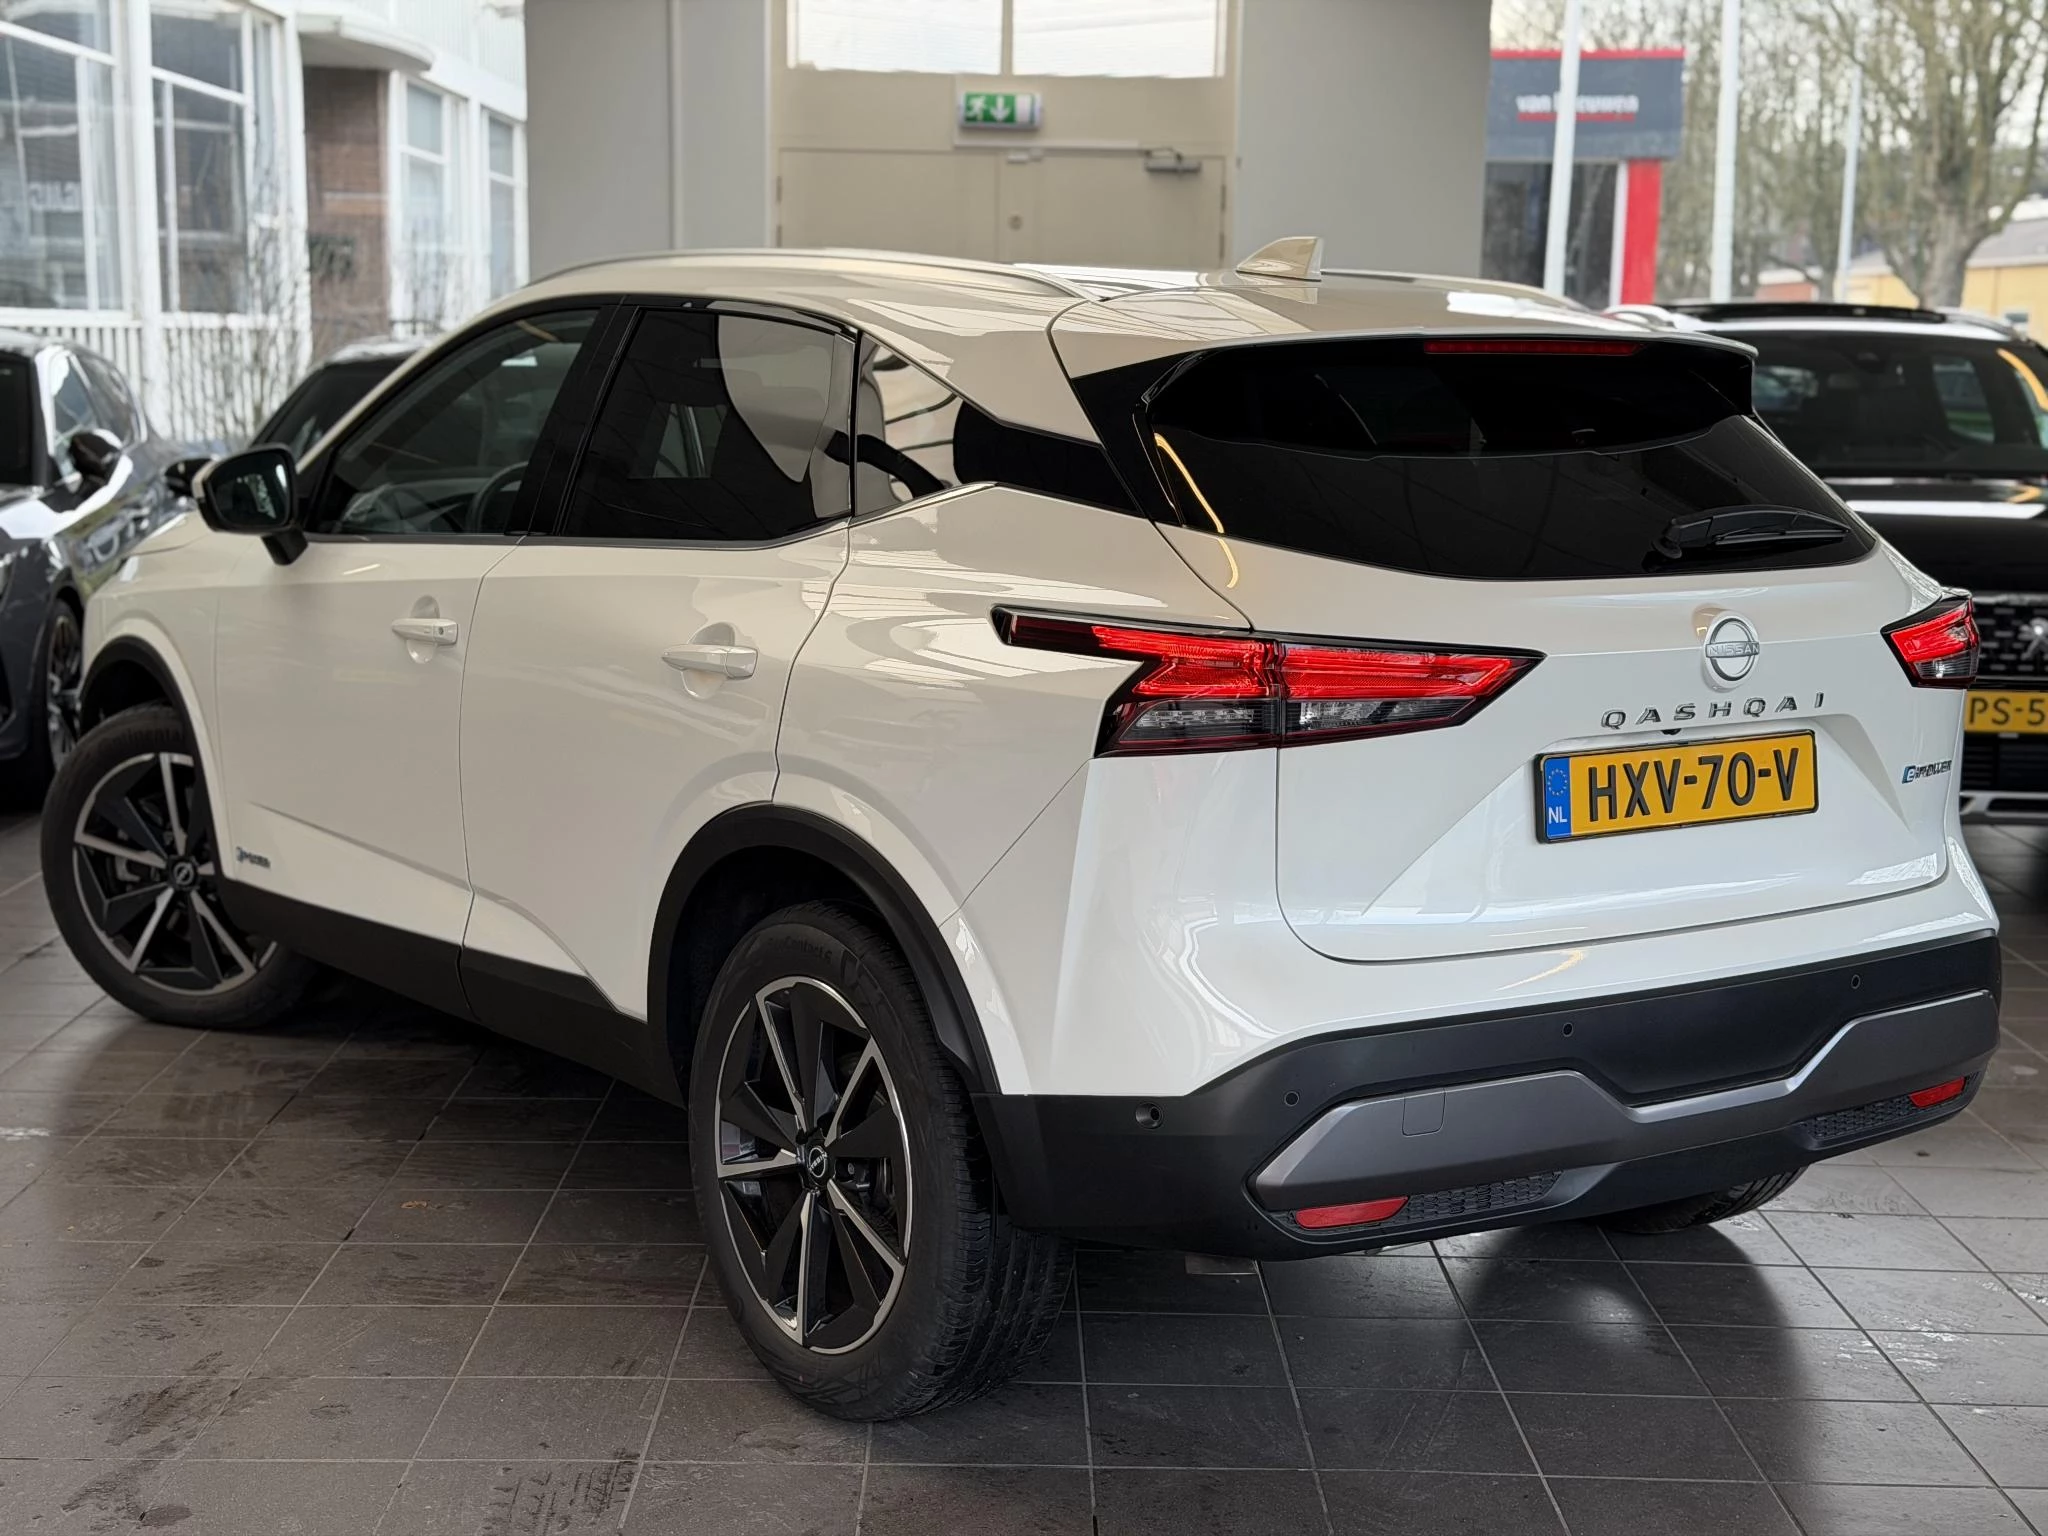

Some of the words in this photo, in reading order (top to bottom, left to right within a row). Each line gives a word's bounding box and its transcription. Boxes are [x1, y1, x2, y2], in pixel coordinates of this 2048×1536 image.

[1708, 643, 1759, 656] NISSAN
[1601, 692, 1824, 729] QASHQAI
[1969, 697, 2045, 726] PS-5
[1587, 747, 1800, 822] HXV-70-V
[1548, 806, 1568, 824] NL
